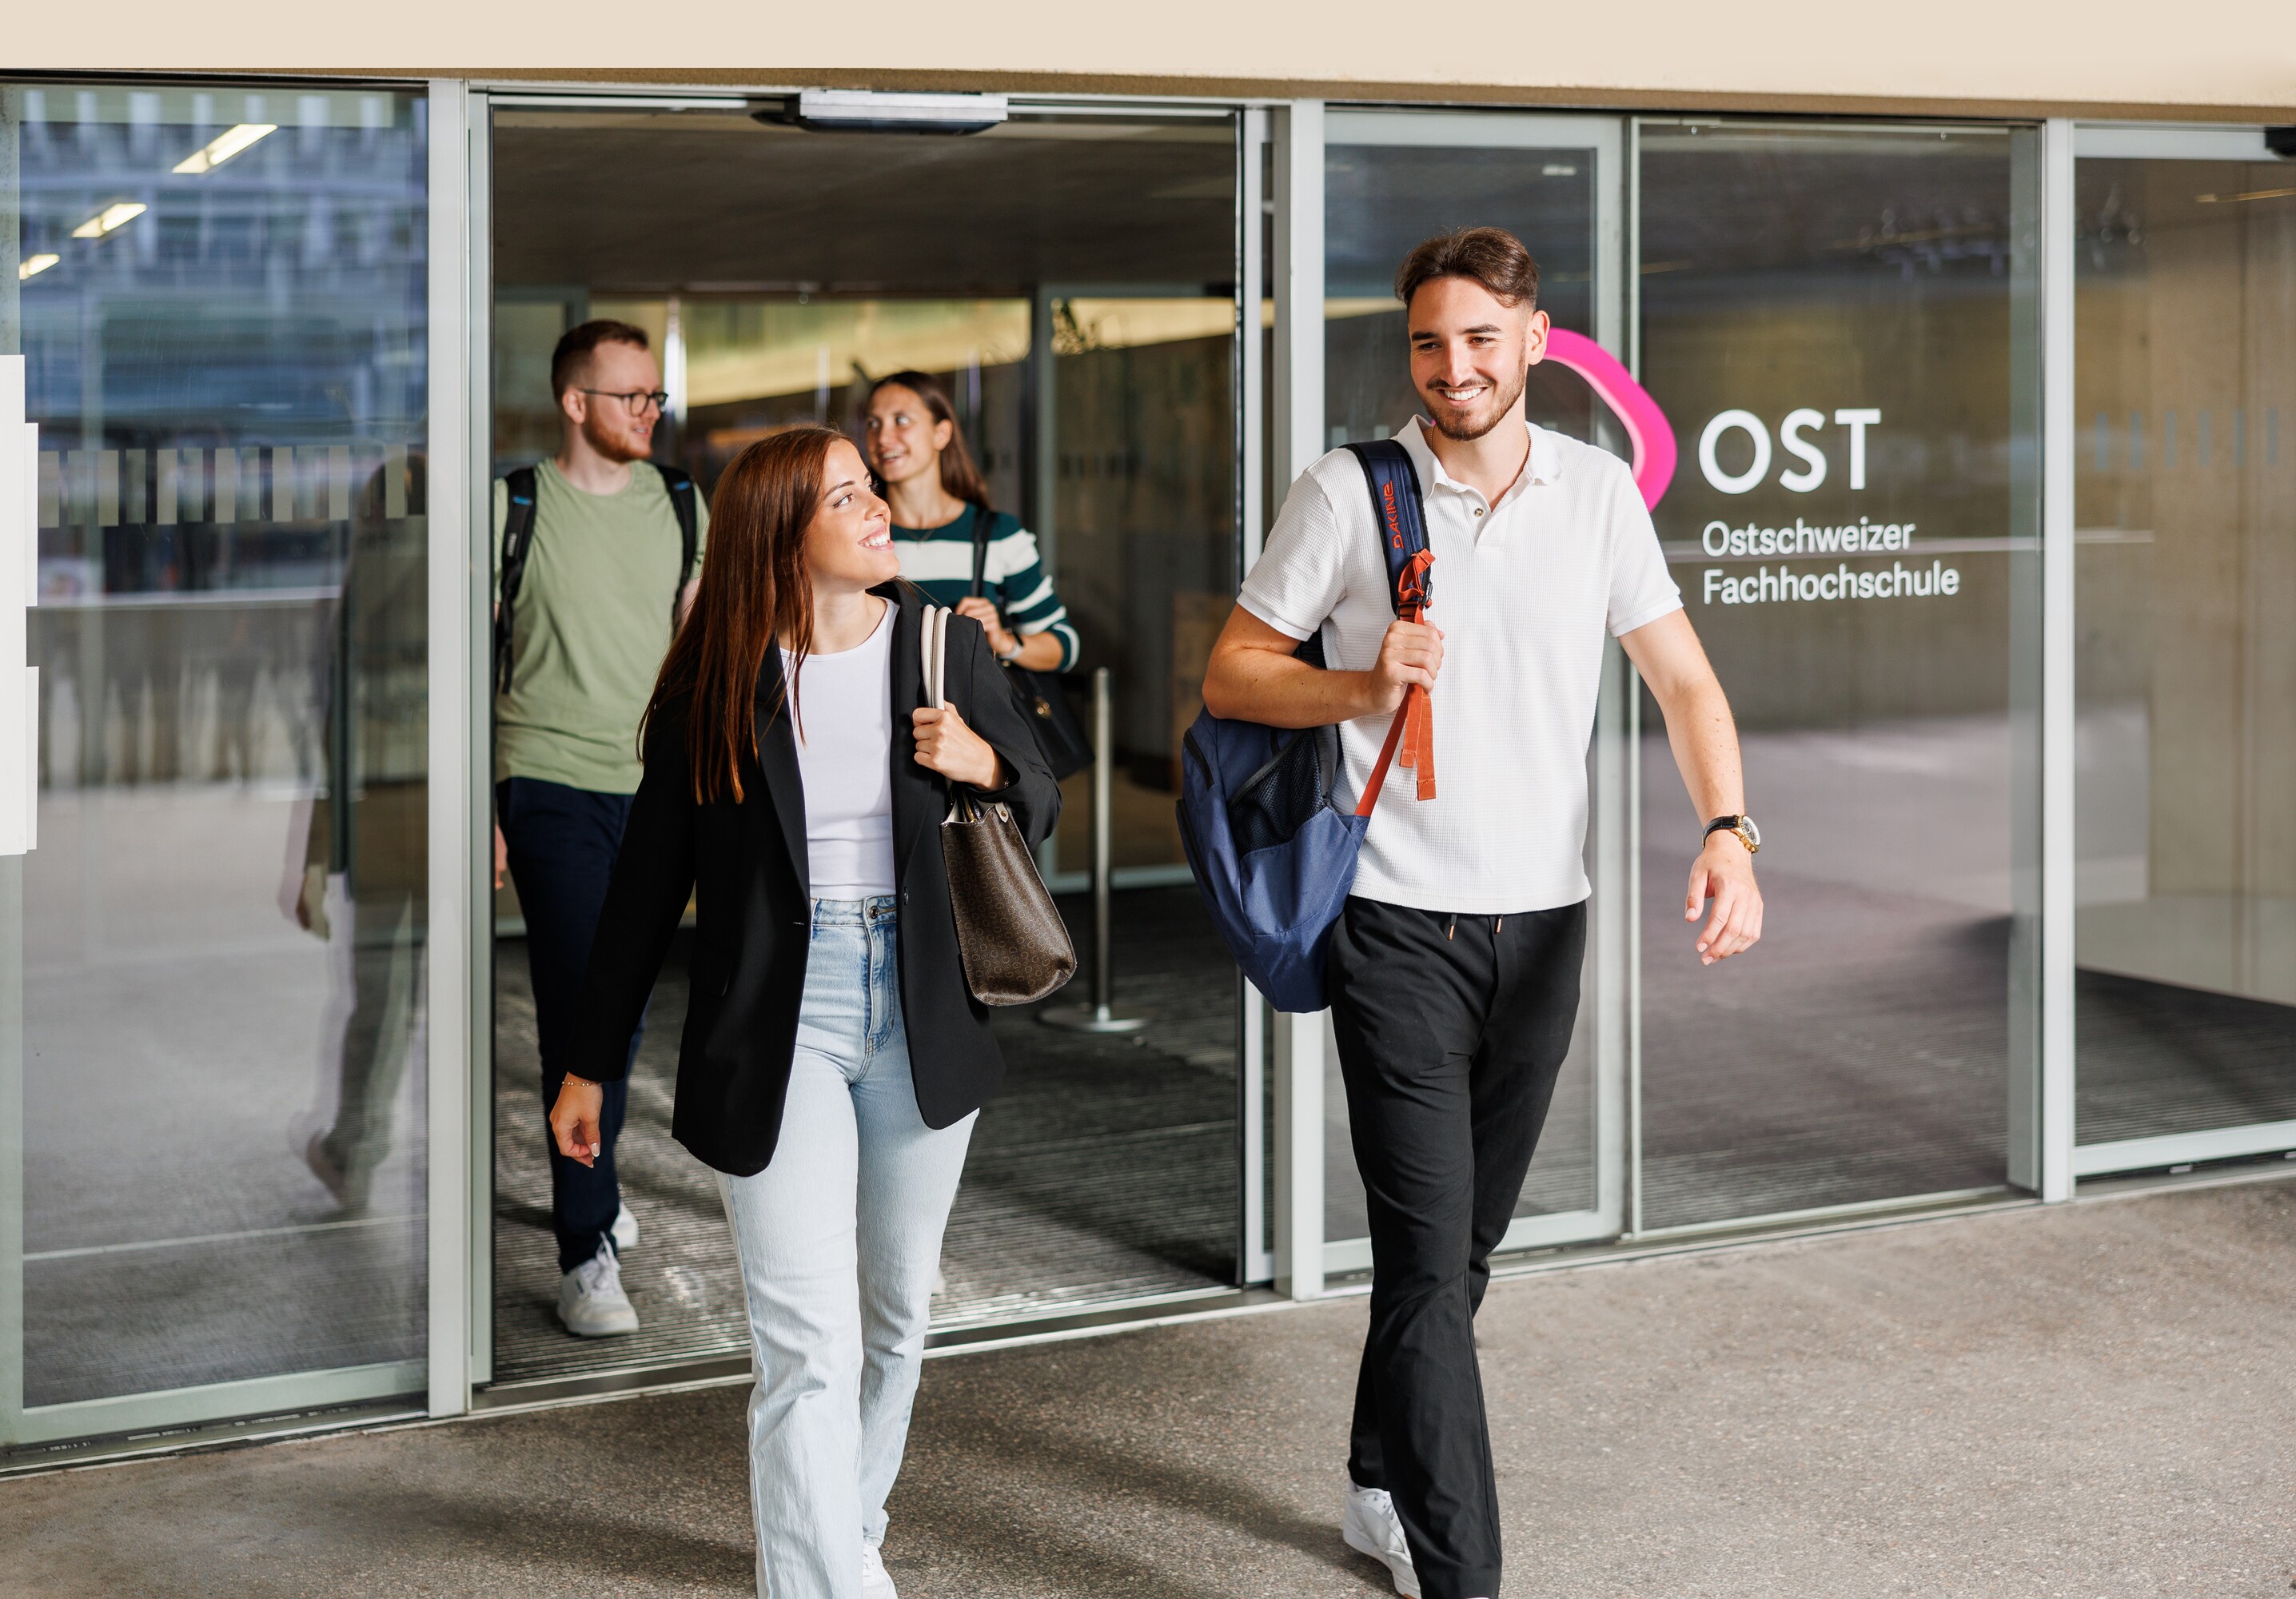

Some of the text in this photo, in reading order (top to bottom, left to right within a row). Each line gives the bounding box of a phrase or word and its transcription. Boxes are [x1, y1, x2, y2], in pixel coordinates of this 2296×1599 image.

[1698, 408, 1881, 494] OST
[1382, 480, 1405, 549] DAKINE
[1702, 516, 1916, 557] Ostschweizer
[1704, 560, 1960, 605] Fachhochschule
